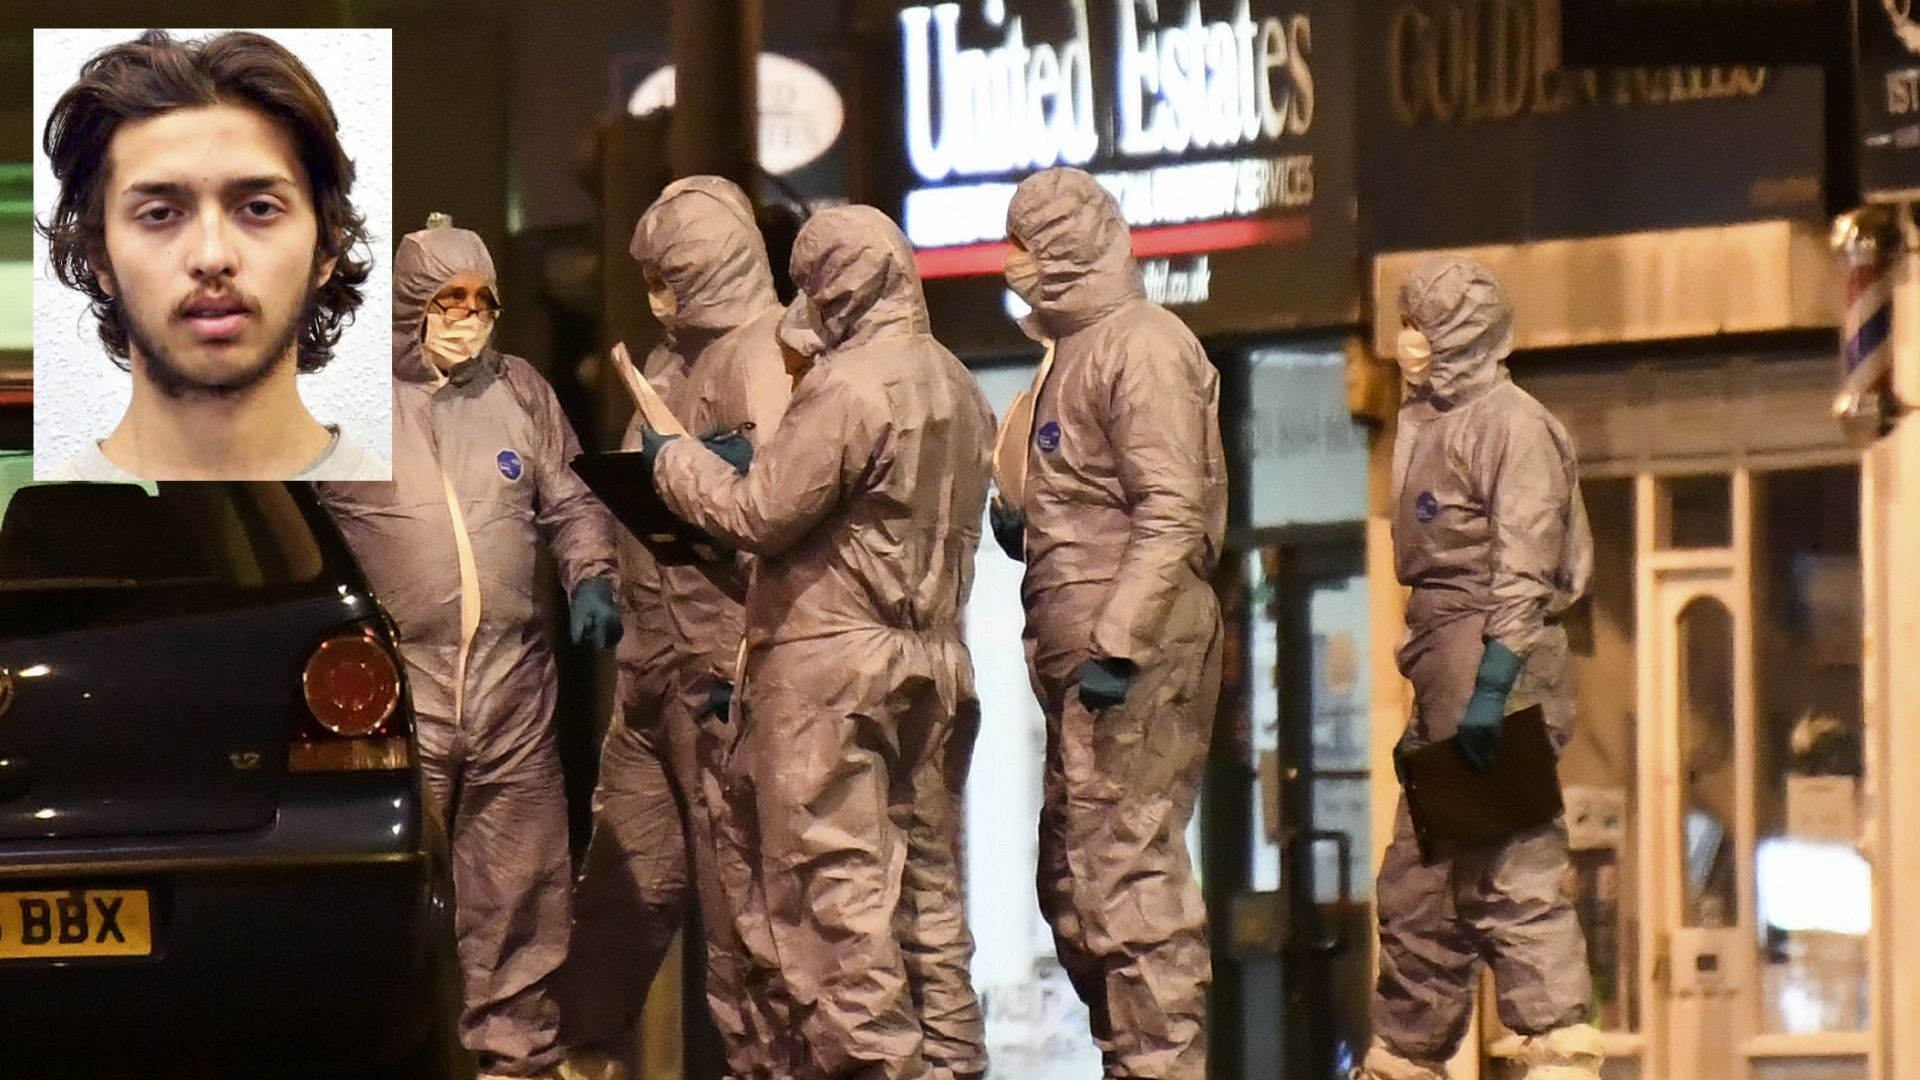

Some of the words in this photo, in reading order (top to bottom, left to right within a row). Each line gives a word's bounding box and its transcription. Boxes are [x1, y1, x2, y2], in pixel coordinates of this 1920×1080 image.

[901, 0, 1099, 182] United
[1119, 0, 1316, 156] Estates
[1235, 154, 1314, 213] SERVICES
[19, 897, 126, 945] BBX
